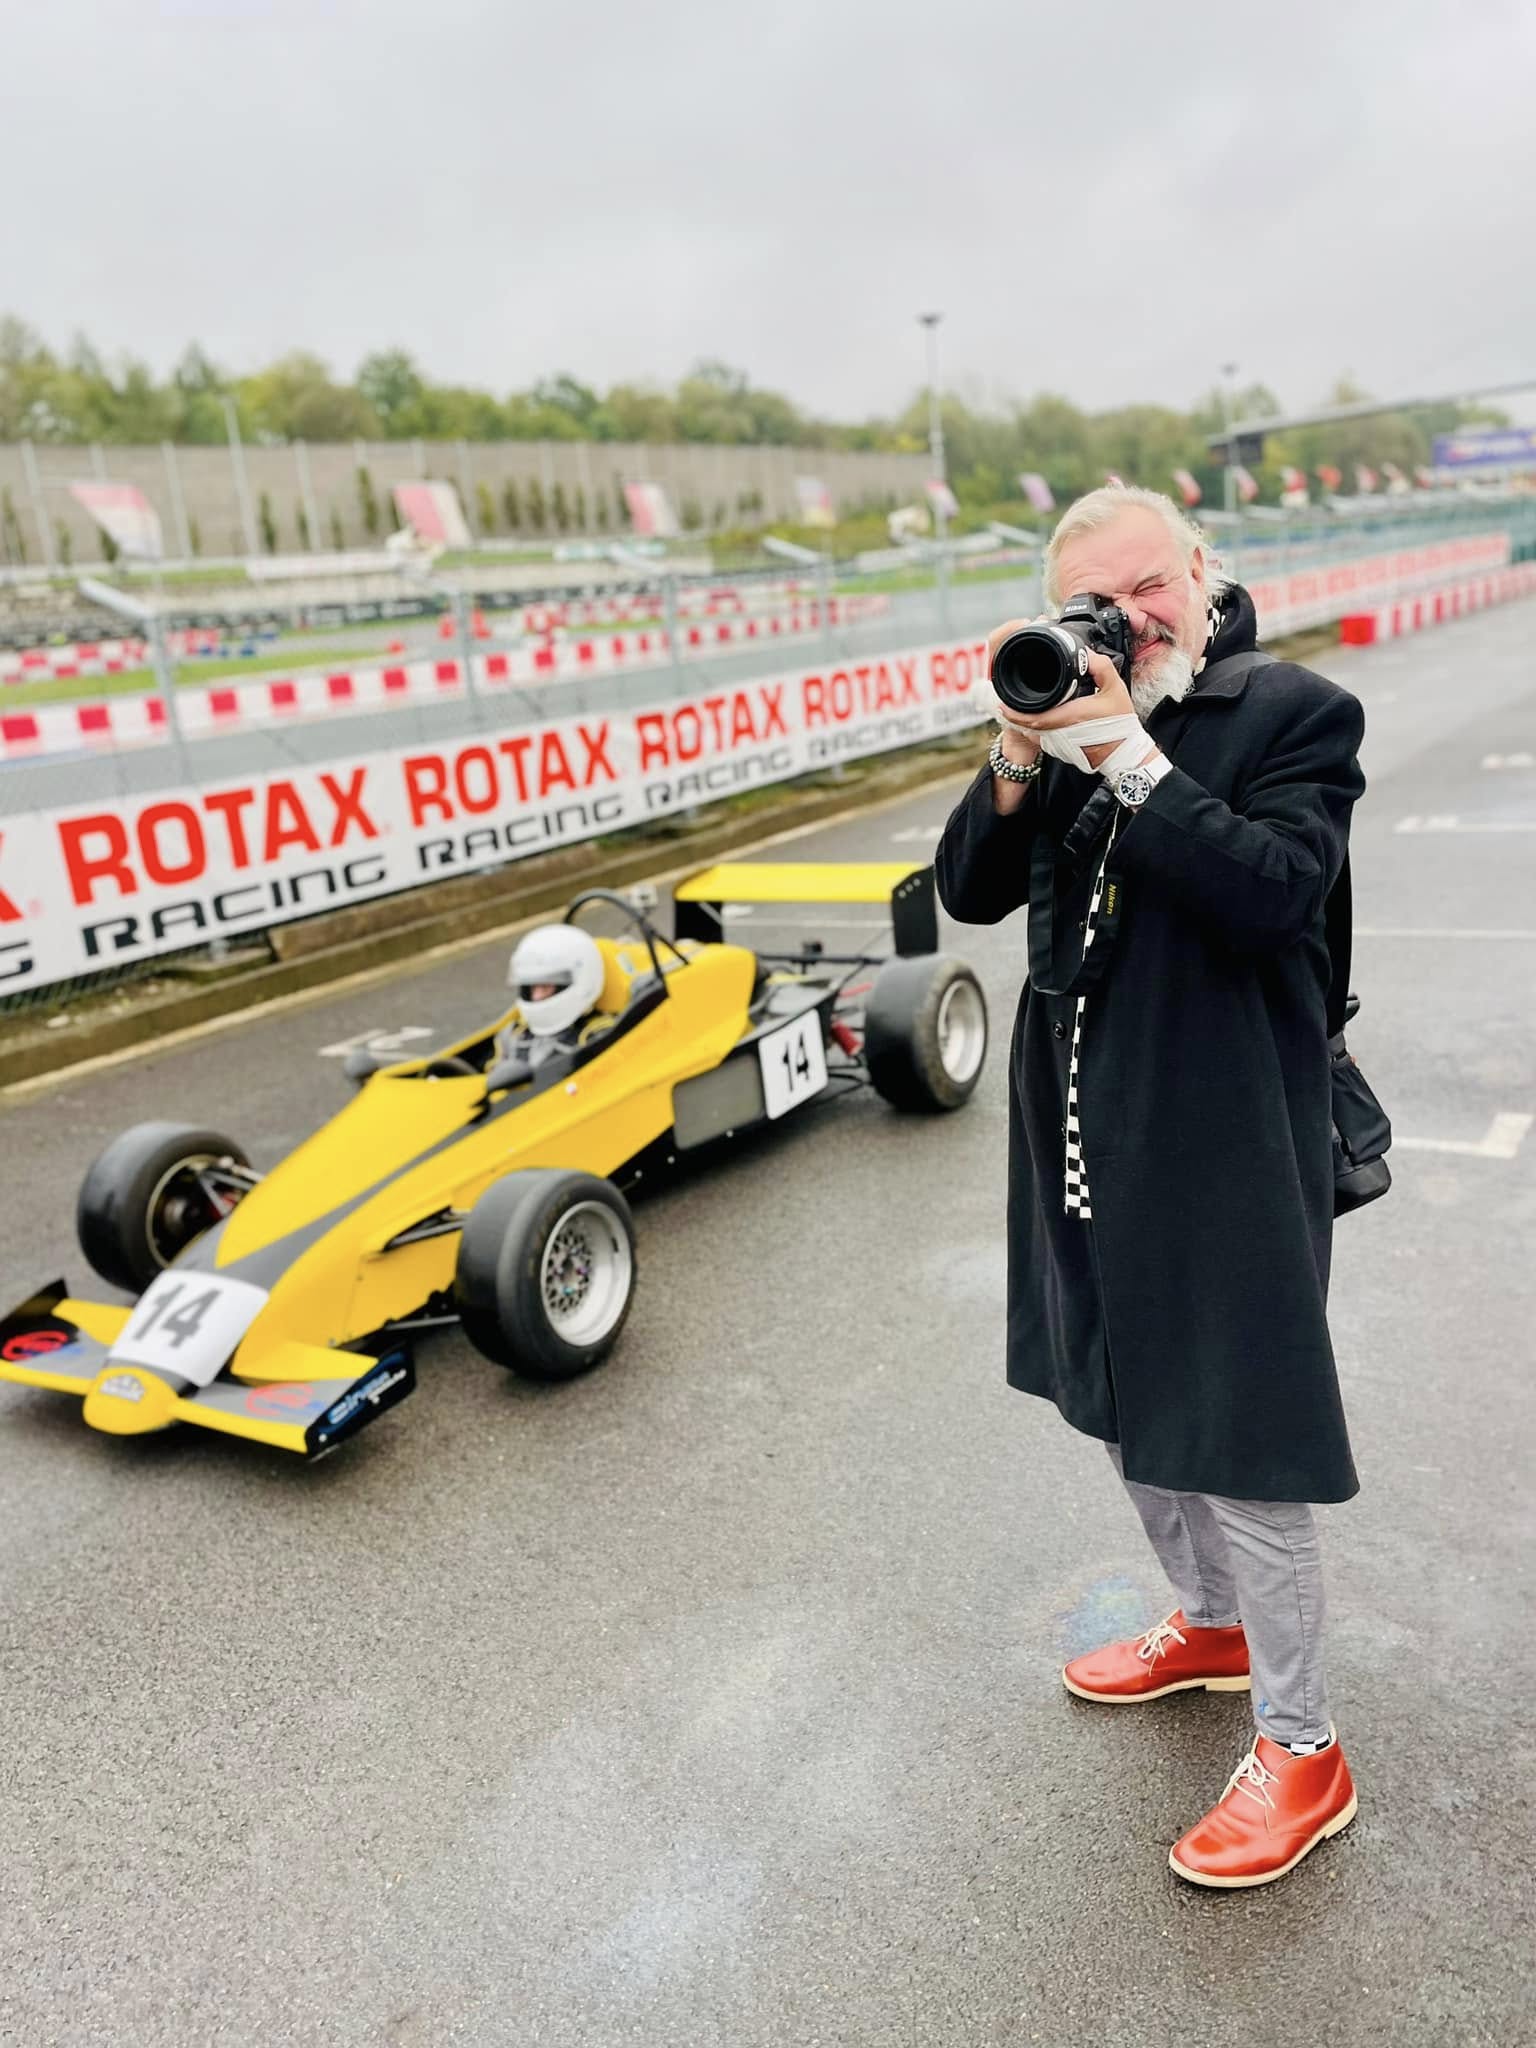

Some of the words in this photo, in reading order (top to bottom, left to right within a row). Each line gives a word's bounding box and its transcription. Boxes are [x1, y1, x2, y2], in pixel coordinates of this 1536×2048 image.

[56, 767, 378, 906] ROTAX
[403, 722, 616, 828] ROTAX
[634, 686, 787, 773] ROTAX
[802, 660, 920, 728] ROTAX
[930, 643, 987, 697] ROT
[82, 855, 387, 957] RACING
[419, 793, 625, 870] RACING
[644, 745, 794, 811] RACING
[1106, 883, 1117, 915] Nikon
[781, 1031, 809, 1093] 14
[132, 1282, 223, 1349] 14
